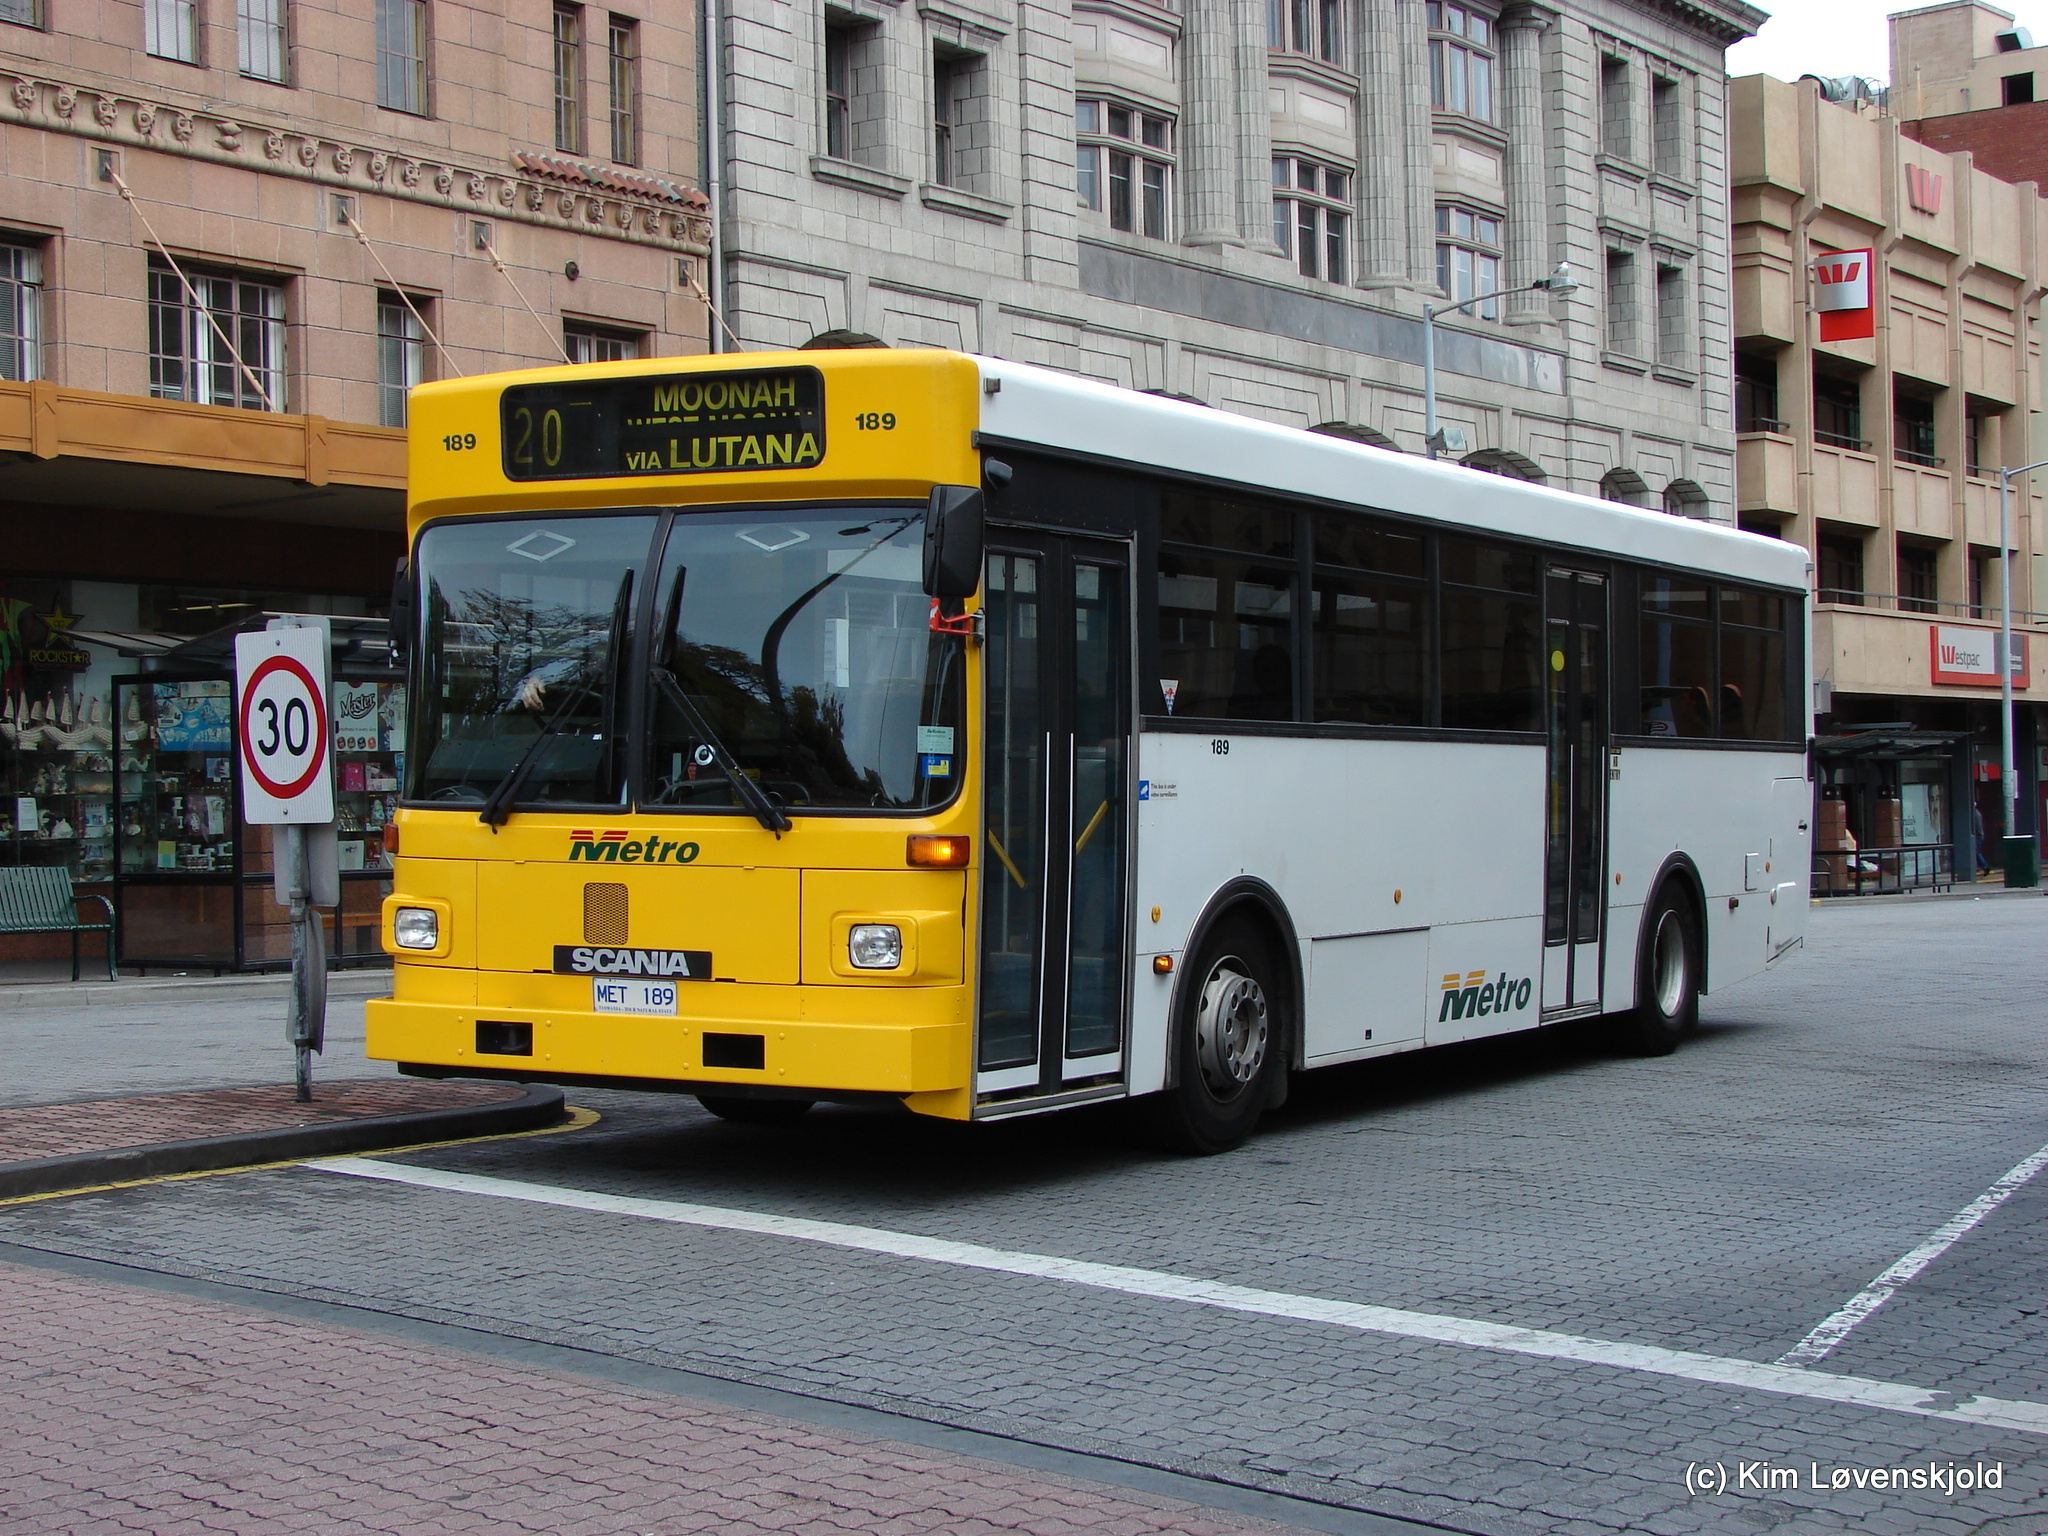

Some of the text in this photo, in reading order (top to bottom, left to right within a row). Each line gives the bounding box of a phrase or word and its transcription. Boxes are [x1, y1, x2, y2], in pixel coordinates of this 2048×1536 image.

[654, 377, 796, 412] MOONAH
[514, 407, 562, 466] 20
[855, 413, 896, 432] 189
[443, 434, 476, 451] 189
[626, 432, 819, 470] VIA LUTANA
[1941, 645, 1980, 669] Westpac
[340, 692, 376, 719] Master
[258, 697, 309, 756] 30
[1211, 739, 1229, 755] 189
[569, 830, 700, 863] Metro
[571, 948, 690, 977] SCANIA
[597, 985, 673, 1005] MET 189
[1439, 970, 1531, 1022] Metro
